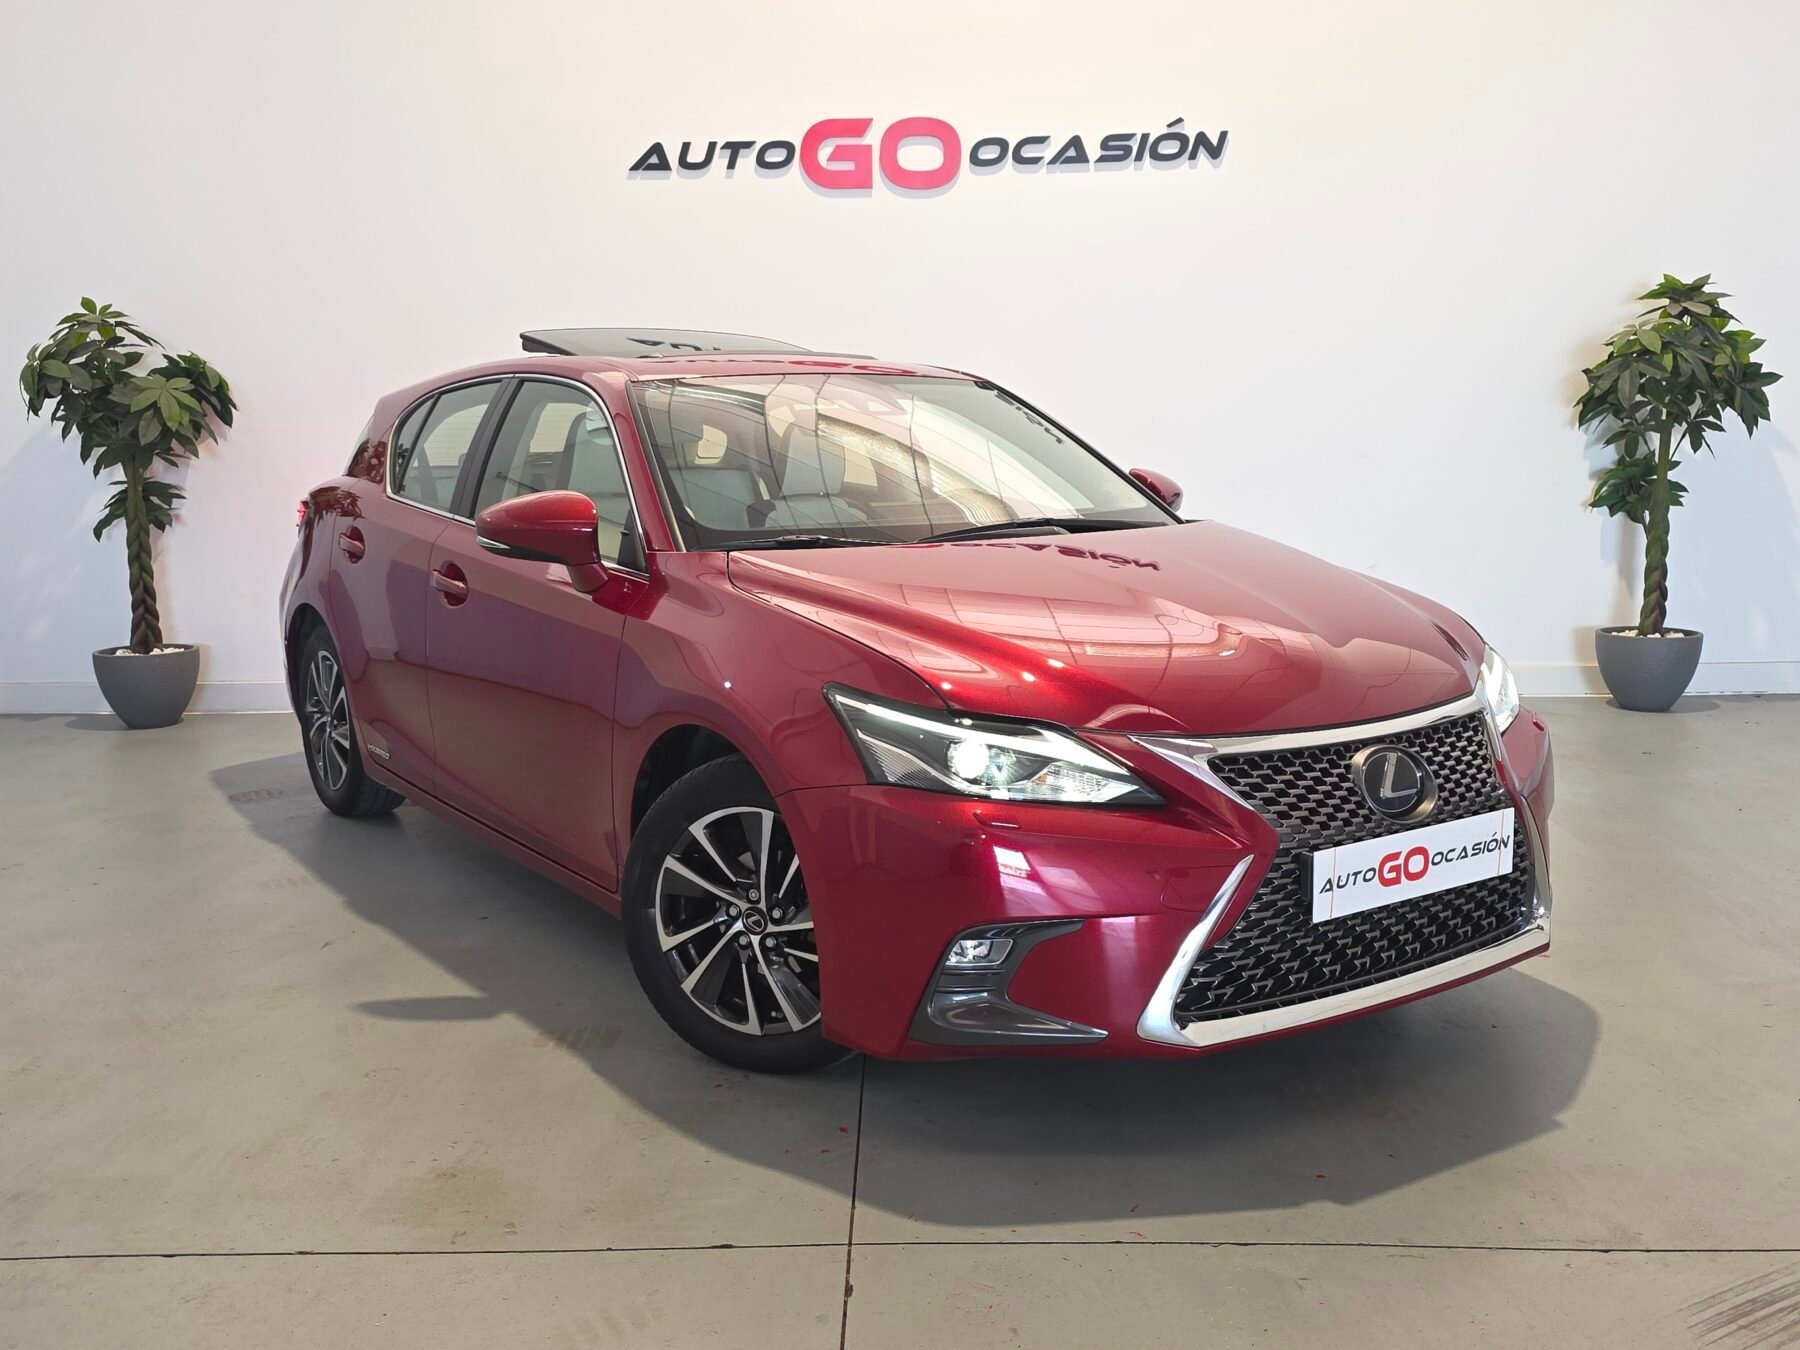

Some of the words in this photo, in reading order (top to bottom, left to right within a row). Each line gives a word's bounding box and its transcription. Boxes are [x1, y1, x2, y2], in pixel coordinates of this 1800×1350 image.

[629, 140, 796, 172] AUTO
[800, 116, 962, 190] GO
[969, 117, 1229, 168] OCASIÓN
[1319, 868, 1377, 895] AUTO
[1377, 846, 1430, 888] GO
[1431, 832, 1511, 866] OCASIÓN
